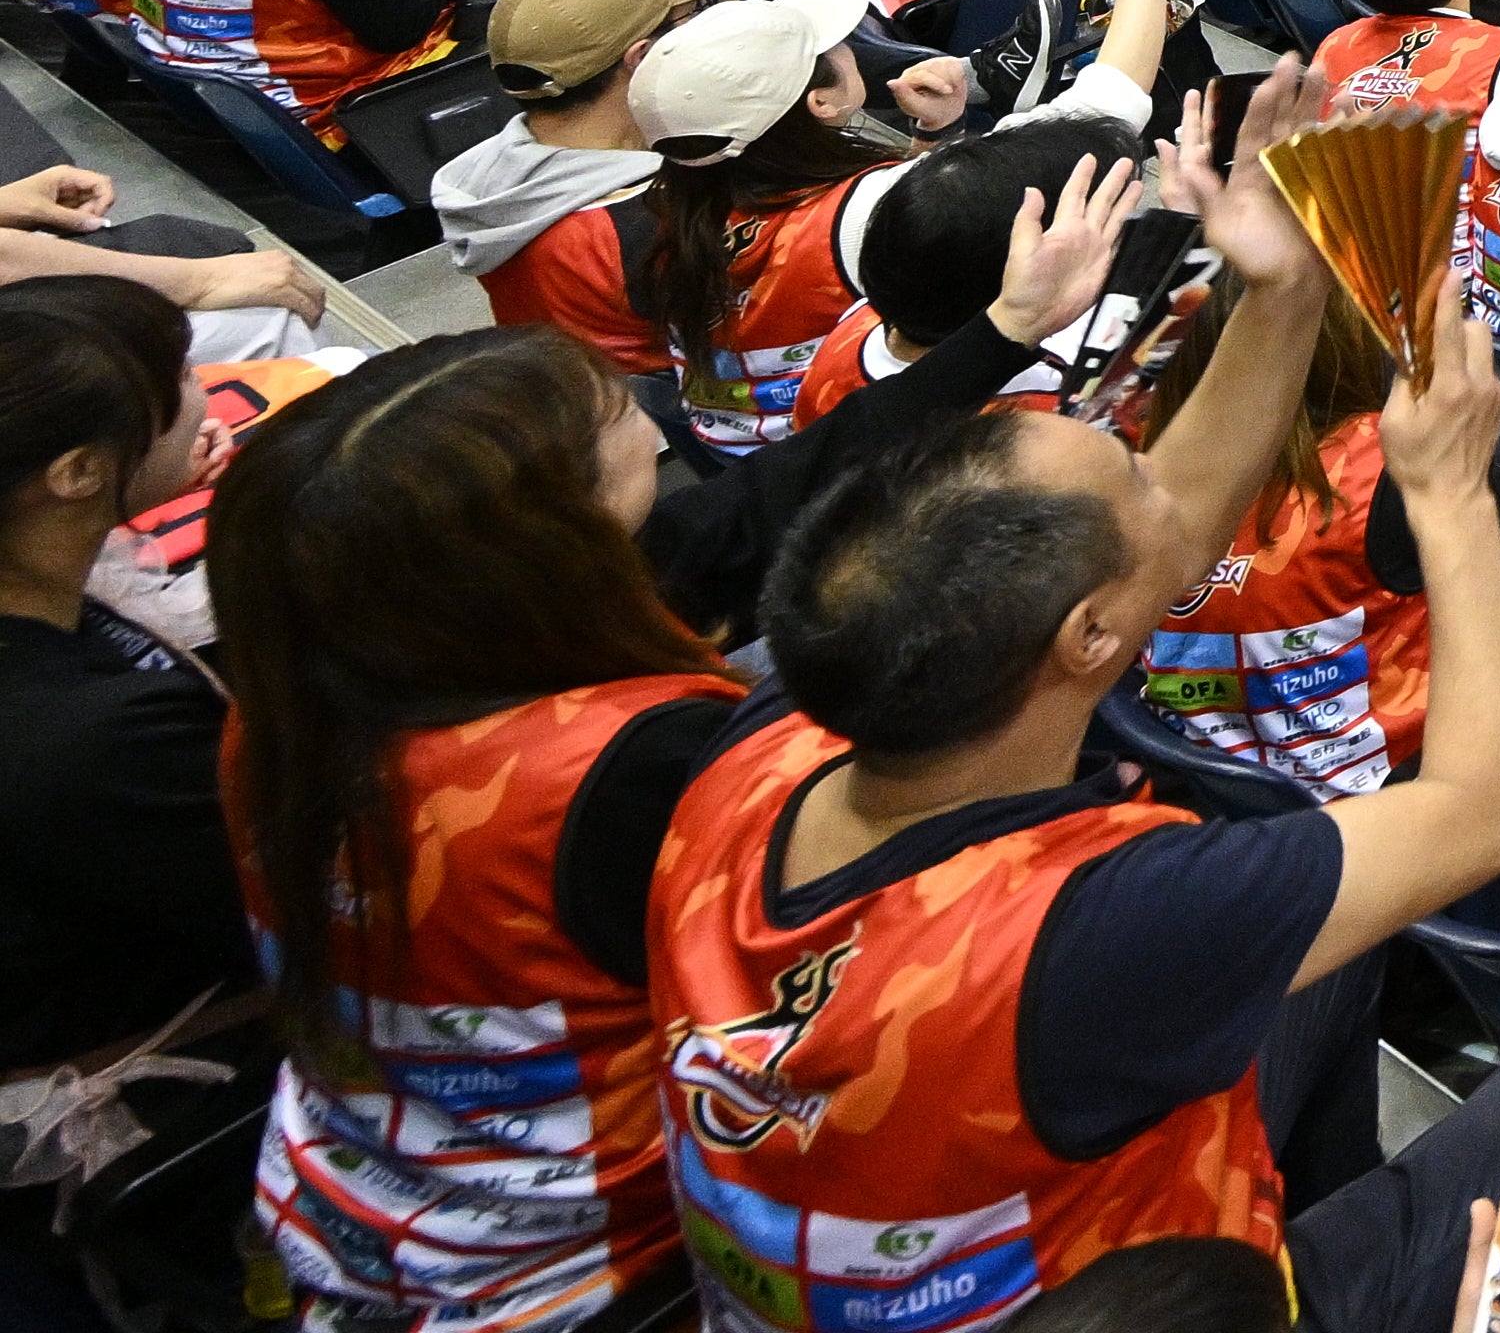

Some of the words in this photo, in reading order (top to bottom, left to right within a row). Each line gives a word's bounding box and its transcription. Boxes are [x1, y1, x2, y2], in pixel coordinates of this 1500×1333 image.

[1347, 68, 1420, 100] EVESSA
[1181, 681, 1226, 700] OFA
[844, 1269, 977, 1326] mizuho
